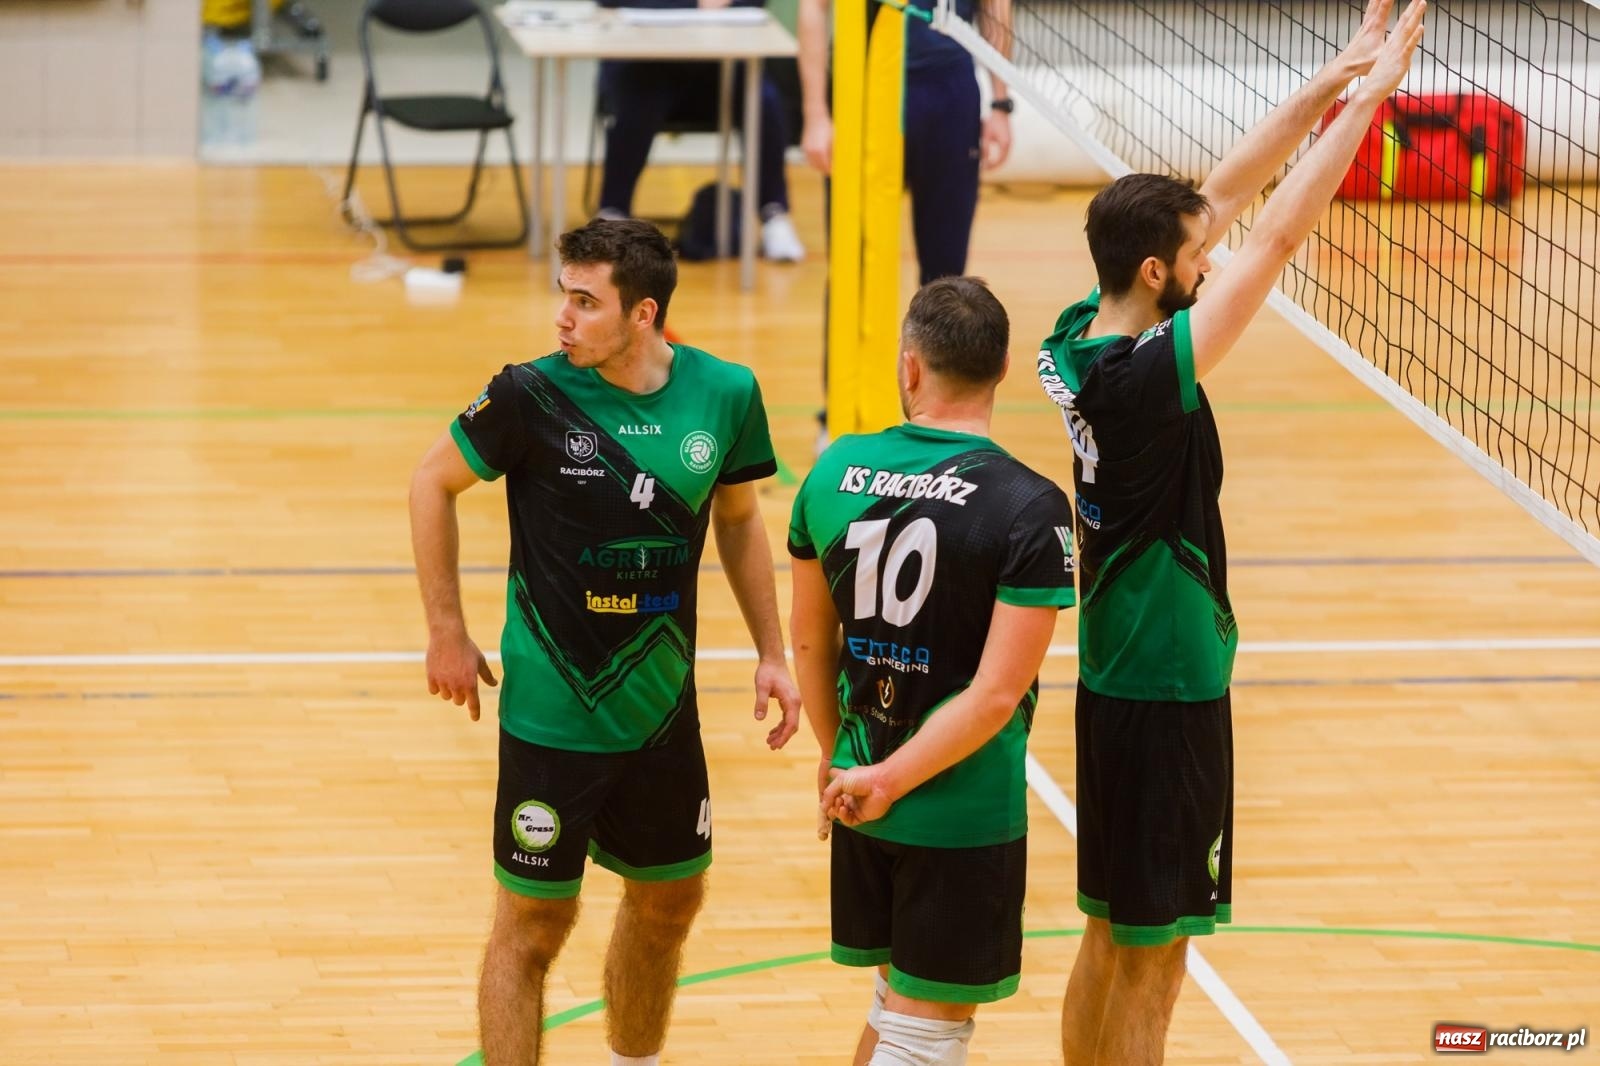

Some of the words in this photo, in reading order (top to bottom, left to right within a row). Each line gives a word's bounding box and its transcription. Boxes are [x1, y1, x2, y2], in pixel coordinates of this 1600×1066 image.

[618, 424, 662, 435] ALLSIX
[560, 467, 605, 477] RACIBÓRZ
[630, 473, 655, 509] 4
[839, 466, 871, 493] KS
[867, 465, 979, 506] RACIBÓRZ
[577, 545, 689, 569] AGROTIM
[616, 569, 659, 580] KIETRZ
[844, 517, 937, 627] 10
[696, 797, 711, 840] 4
[512, 852, 549, 867] ALLSIX
